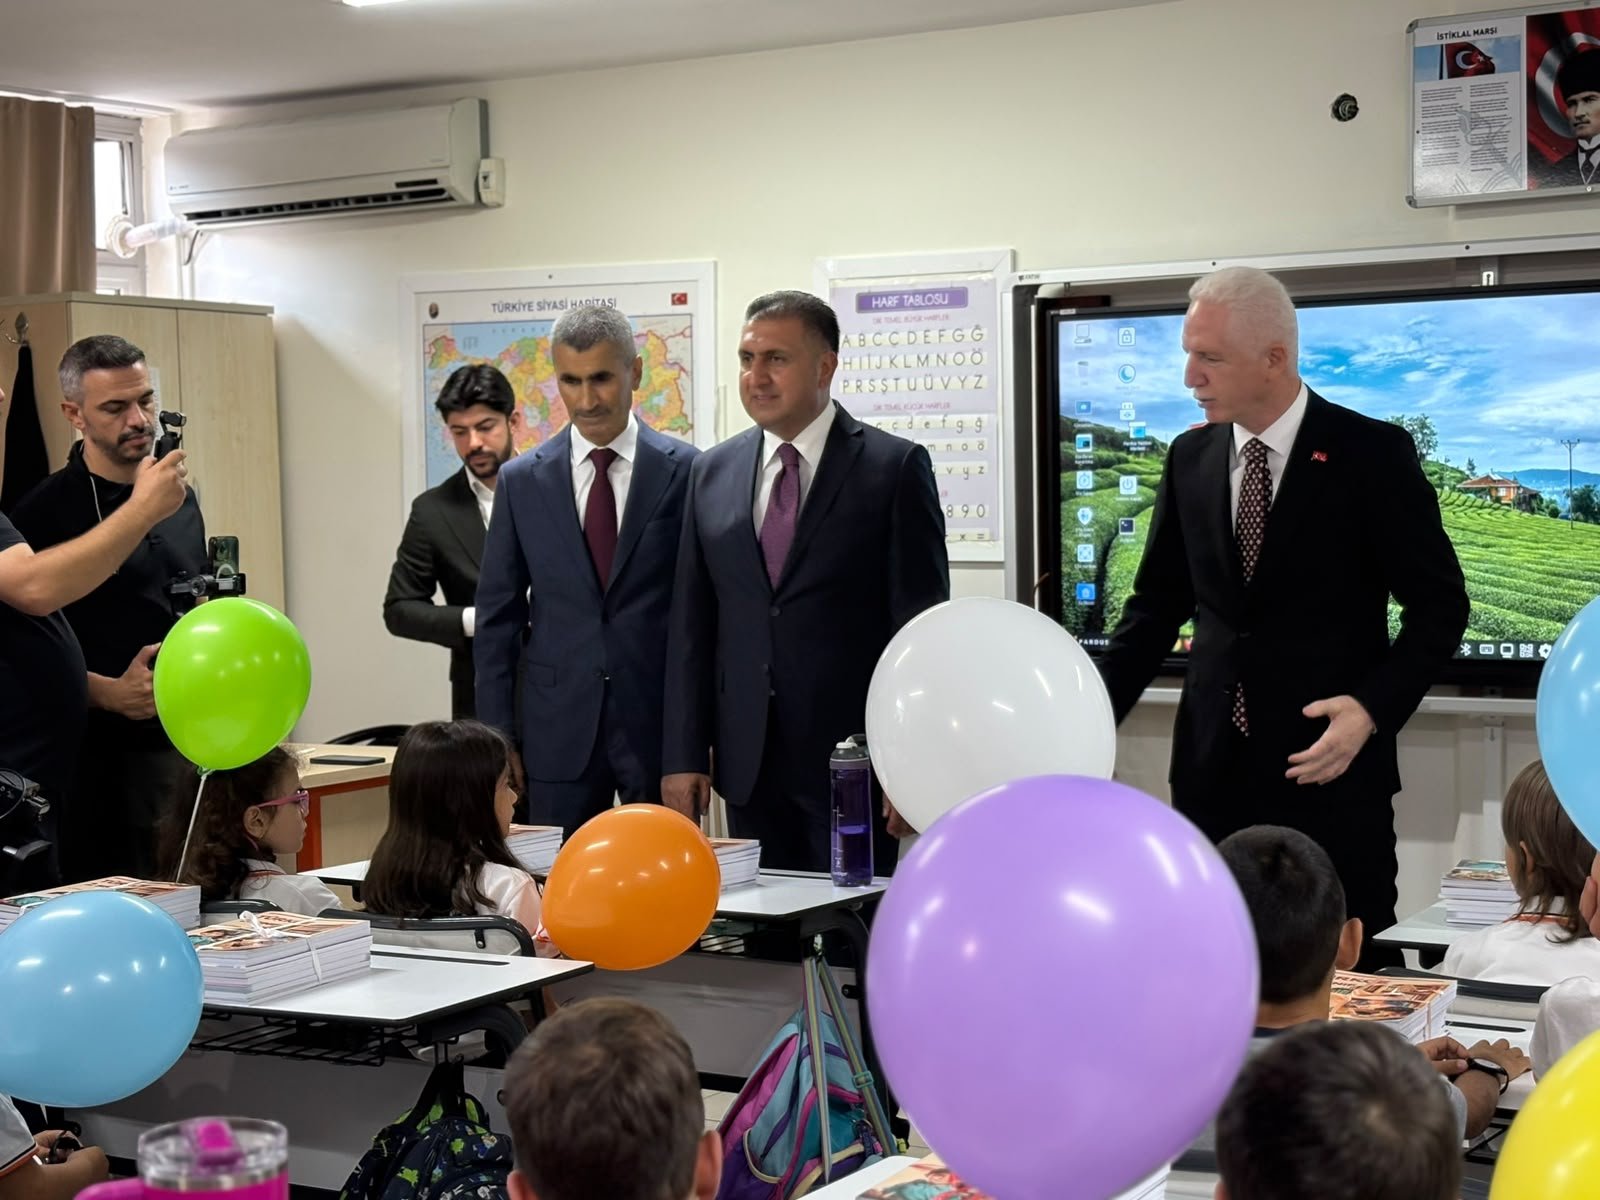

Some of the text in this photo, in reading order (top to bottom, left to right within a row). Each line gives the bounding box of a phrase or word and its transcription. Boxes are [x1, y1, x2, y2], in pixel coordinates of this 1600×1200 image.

[1436, 26, 1498, 41] İSTİKLAL MARŞI
[491, 299, 534, 313] TÜRKİYE
[536, 297, 568, 311] SİYASİ
[872, 293, 949, 309] HARF TABLOSU
